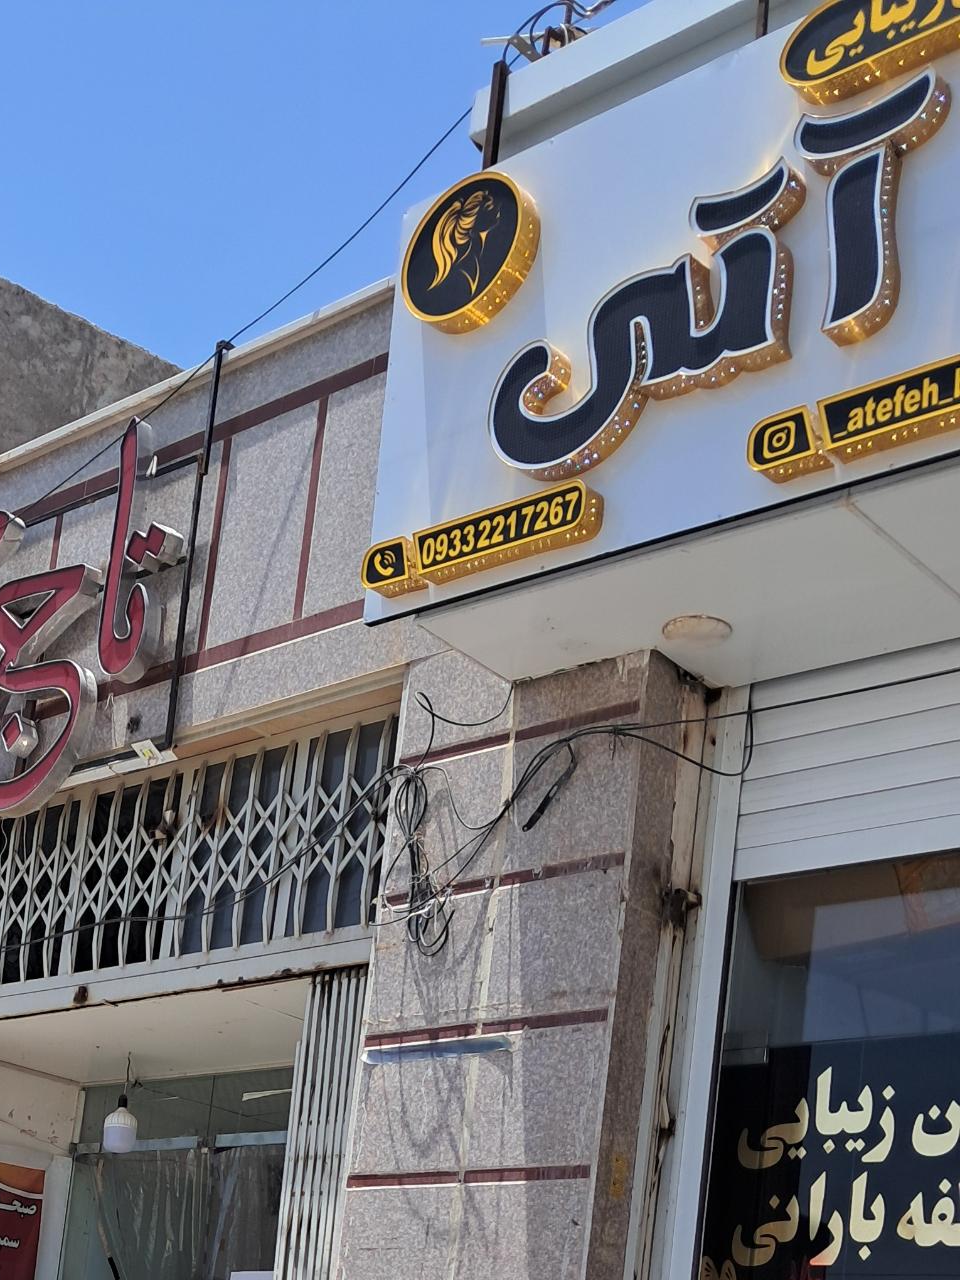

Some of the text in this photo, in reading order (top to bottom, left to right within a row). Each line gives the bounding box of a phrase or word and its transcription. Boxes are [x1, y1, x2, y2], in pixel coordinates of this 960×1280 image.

[421, 490, 579, 566] 09332217267
[737, 1066, 896, 1169] زیبایی
[732, 1171, 886, 1267] بارانی
